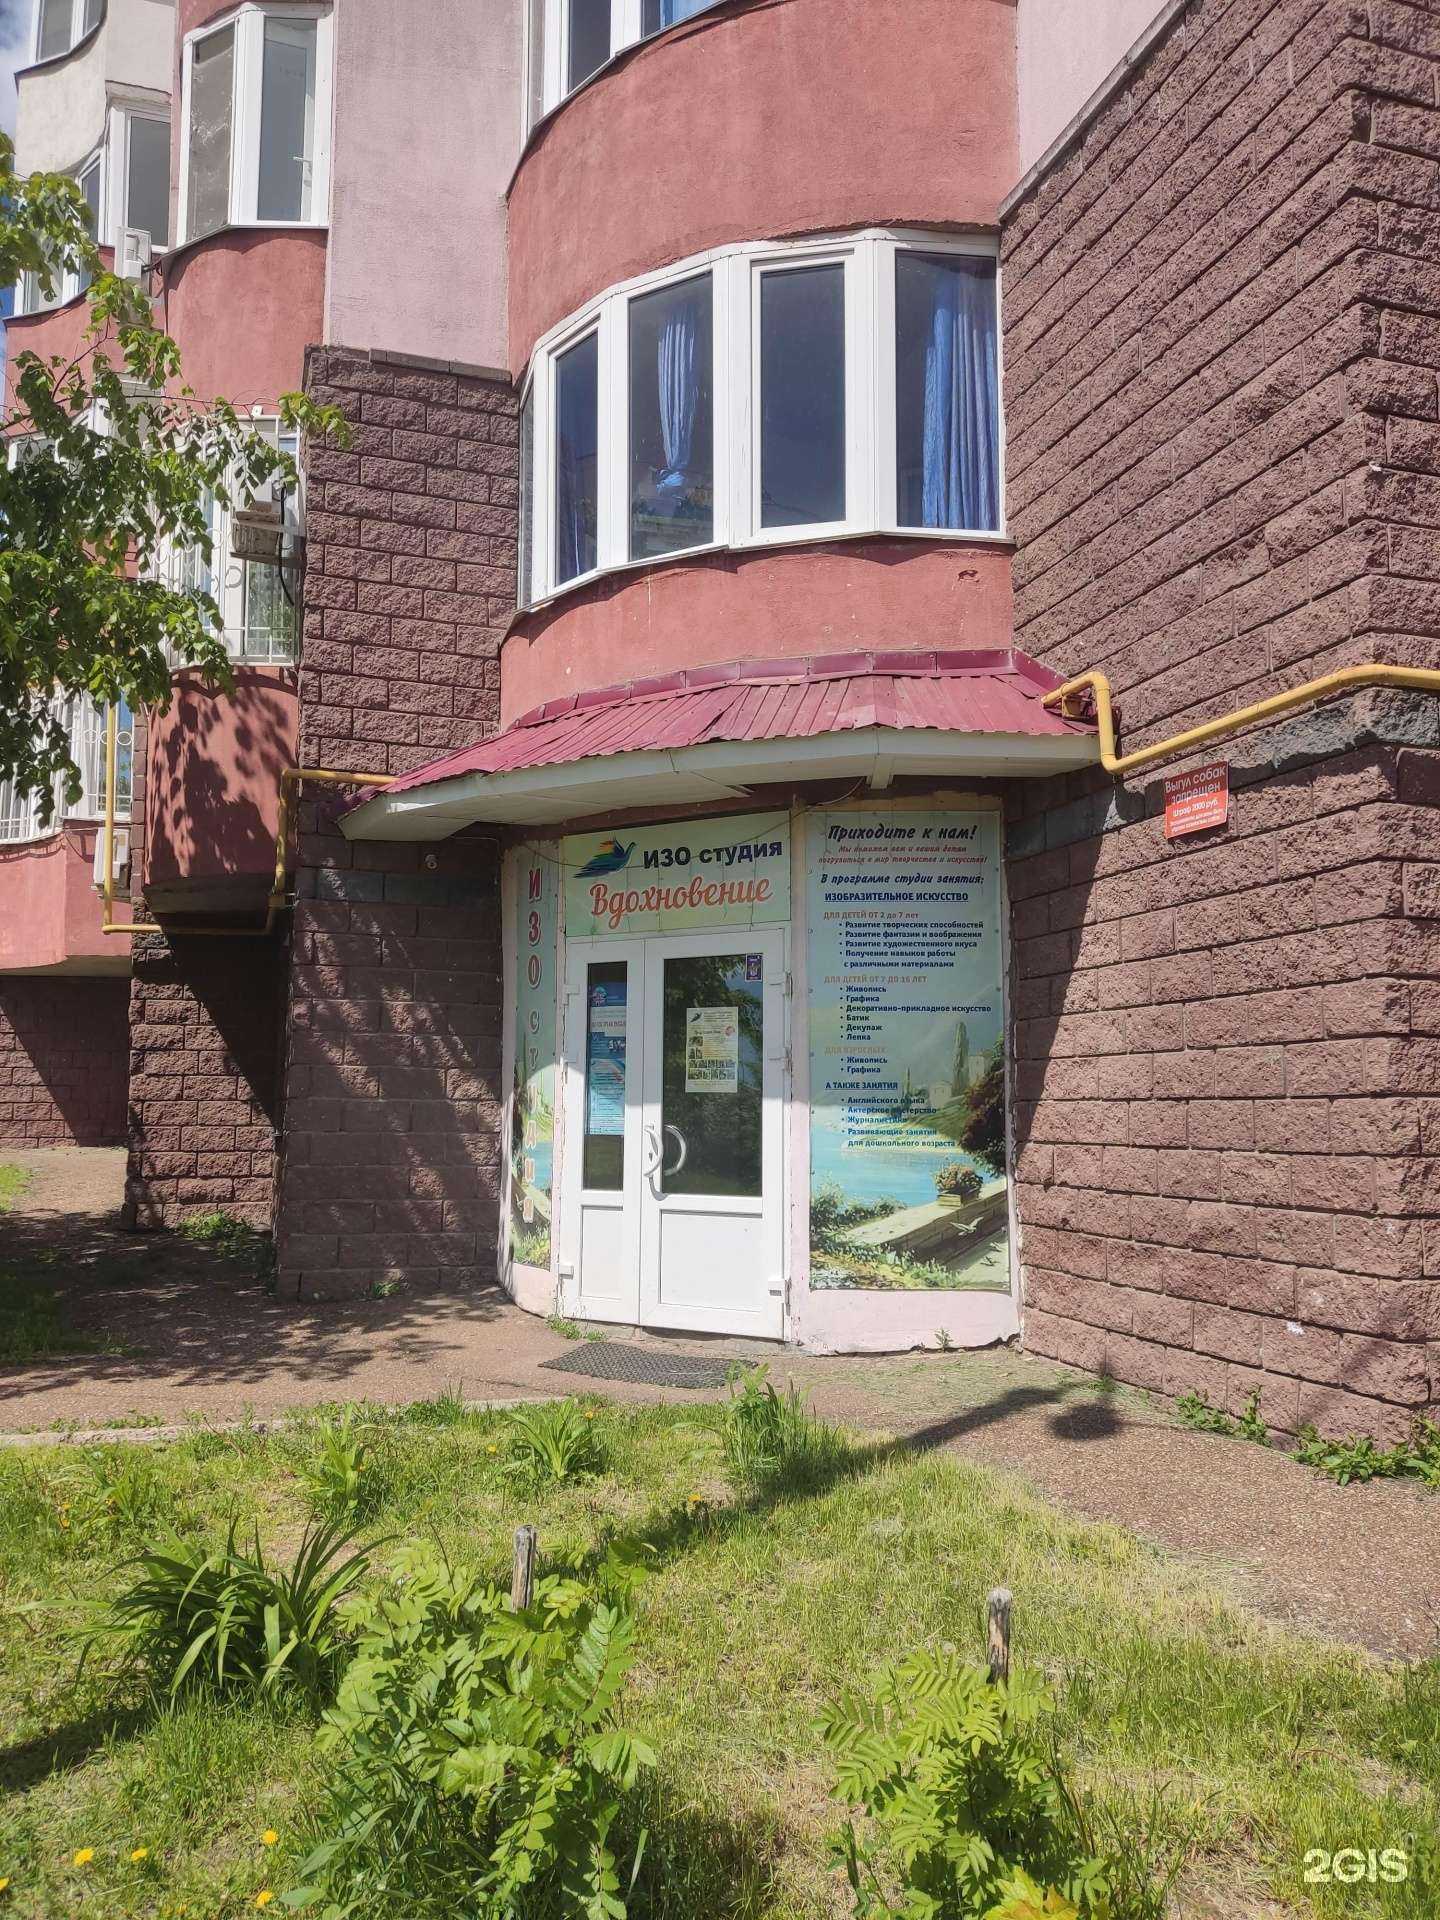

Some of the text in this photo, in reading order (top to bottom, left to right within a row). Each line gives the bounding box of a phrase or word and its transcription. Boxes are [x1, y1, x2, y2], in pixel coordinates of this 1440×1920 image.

[1165, 767, 1225, 793] Выгул собак
[1171, 783, 1220, 804] запрещен
[828, 824, 978, 842] Приходите к нам!
[643, 841, 783, 869] ИЗО студия
[821, 874, 984, 885] В программе студии занятия:
[825, 892, 969, 901] ИЗОБРАЗИТЕЛЬНОЕ ИСКУССТВО
[590, 875, 773, 930] Вдохновение
[824, 911, 840, 920] ДЛЯ
[842, 910, 867, 920] ДЕТЕЙ
[868, 911, 879, 919] ОТ
[880, 911, 886, 919] 2
[899, 911, 904, 919] 7
[528, 868, 542, 990] ИЗО
[845, 921, 984, 929] Развитие творческих способностей
[845, 931, 982, 940] Развитие фантазии и воображения
[845, 940, 977, 949] Развитие художественного вкуса
[845, 950, 956, 959] Получение навыков работы
[850, 961, 900, 969] различными
[901, 961, 954, 969] материалами
[846, 995, 880, 1003] Графика
[846, 1005, 991, 1013] Декоративно-прикладное искусство
[846, 1024, 882, 1032] Декупаж
[847, 1056, 888, 1064] Живопись
[847, 1066, 880, 1074] Графика
[848, 1096, 898, 1105] Английского
[848, 1106, 937, 1114] Актерское мастерство
[848, 1116, 907, 1124] Журналистика
[848, 1128, 937, 1136] Развивающие занятия
[848, 1140, 955, 1148] для дошкольного возраста
